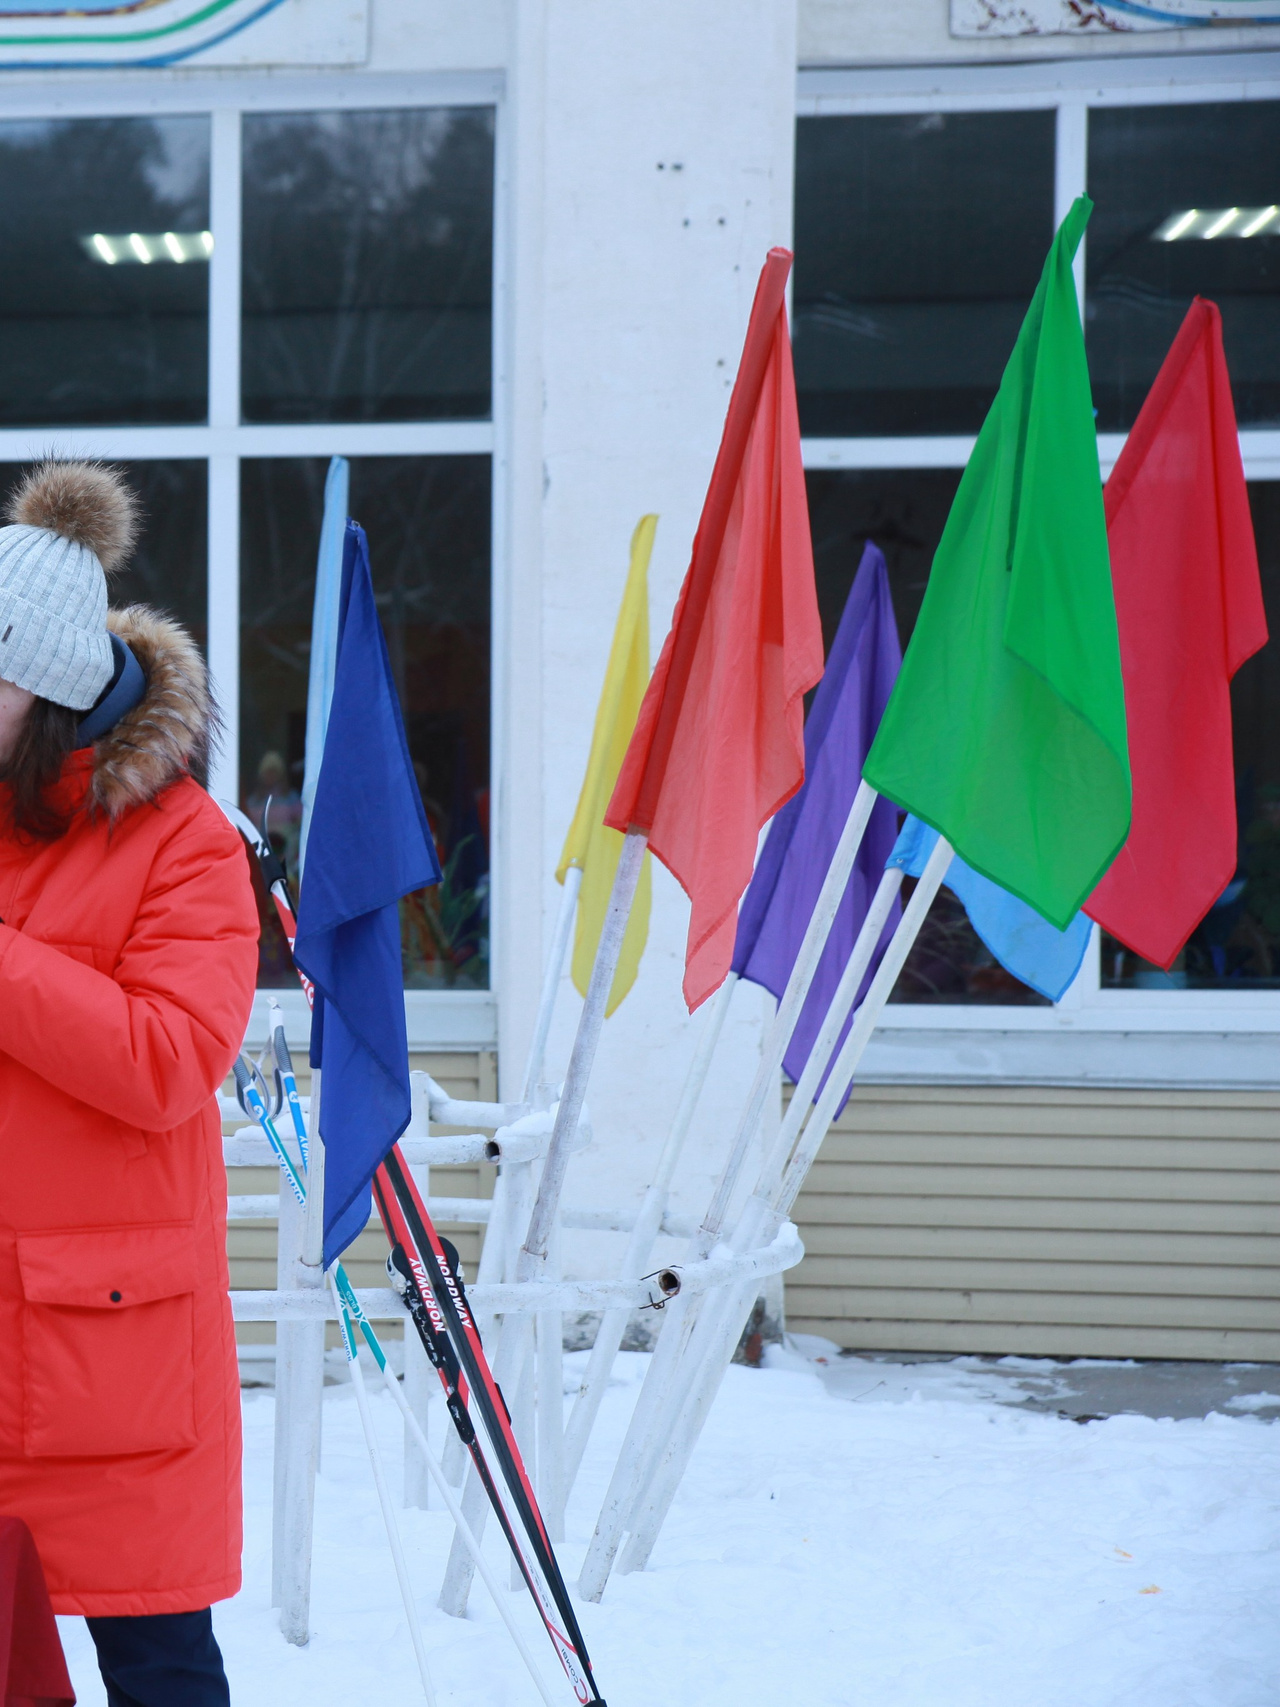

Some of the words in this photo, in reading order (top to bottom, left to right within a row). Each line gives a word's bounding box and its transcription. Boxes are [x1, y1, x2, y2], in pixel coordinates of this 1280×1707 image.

[409, 1257, 446, 1332] NORDWAY
[435, 1254, 472, 1329] NORDWAY
[561, 1648, 579, 1684] COMBI
